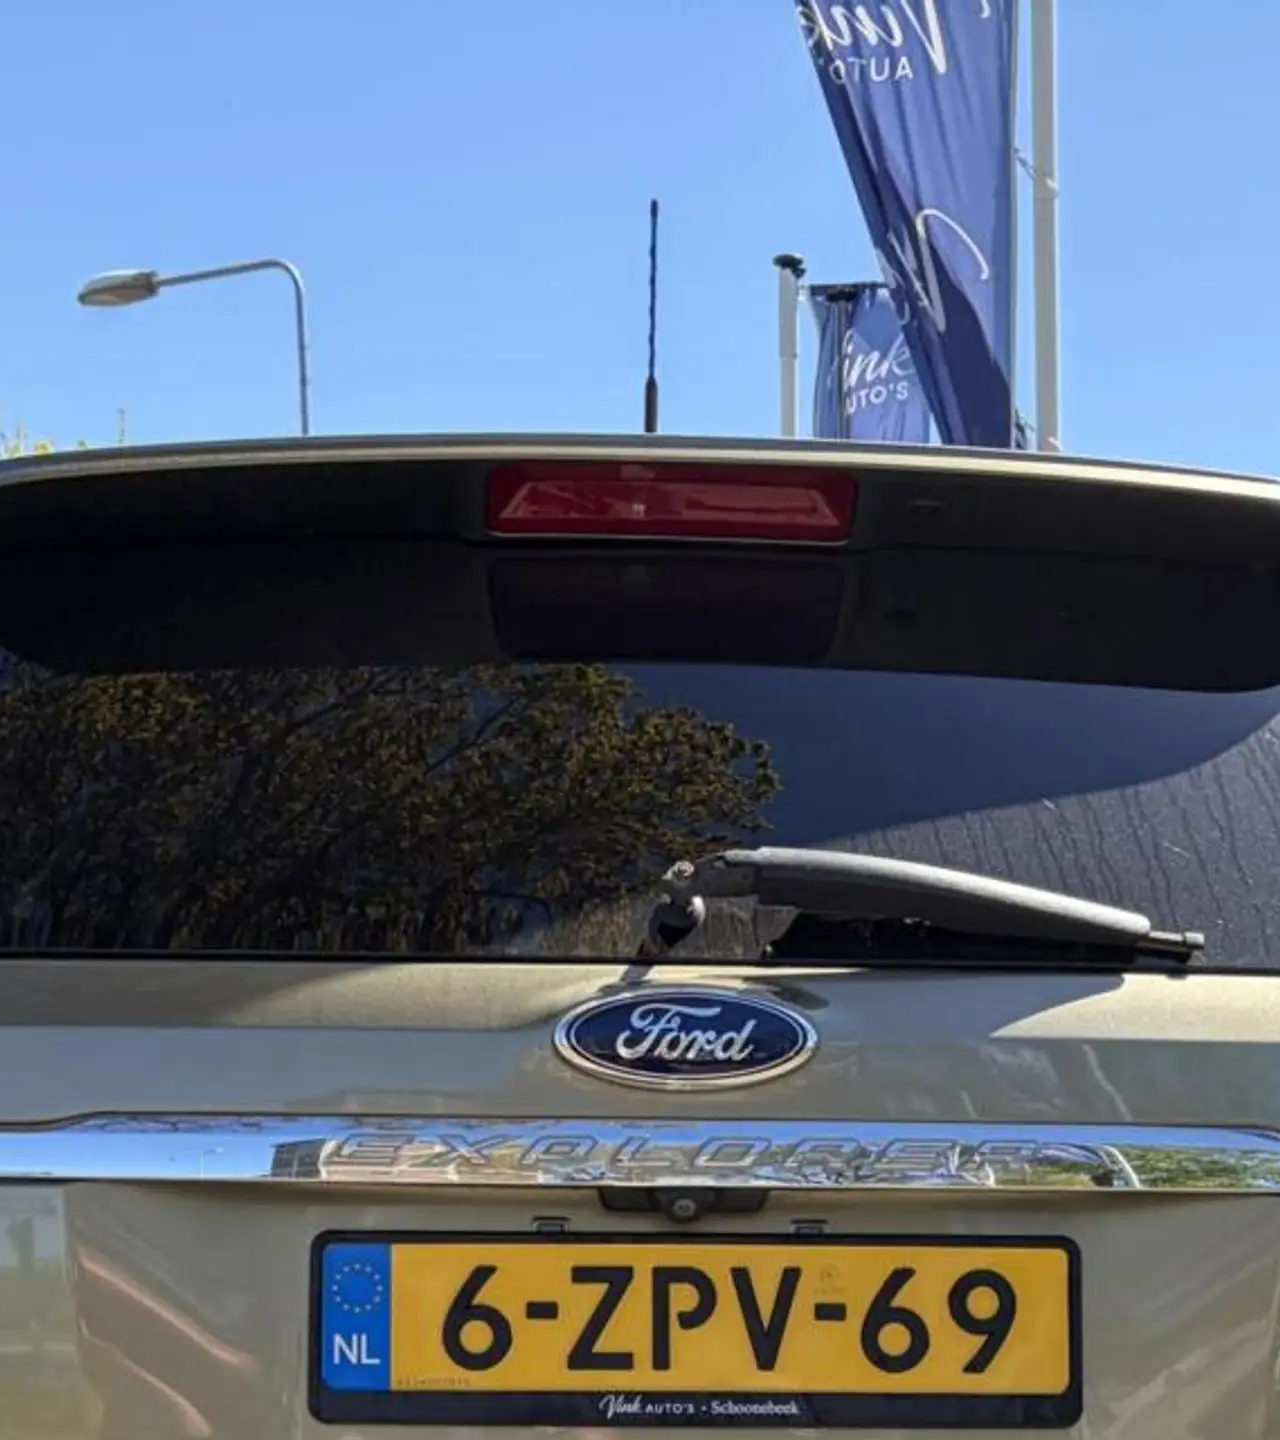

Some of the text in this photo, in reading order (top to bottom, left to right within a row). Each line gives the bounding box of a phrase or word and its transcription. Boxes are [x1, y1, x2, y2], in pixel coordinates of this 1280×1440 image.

[846, 380, 909, 415] UTO'S
[616, 1003, 757, 1060] Ford
[324, 1132, 1045, 1172] EXPLORER
[441, 1264, 1018, 1374] 6-ZPV-69
[332, 1332, 381, 1365] NL
[599, 1394, 643, 1419] Vink
[710, 1400, 800, 1416] Schoonebeek
